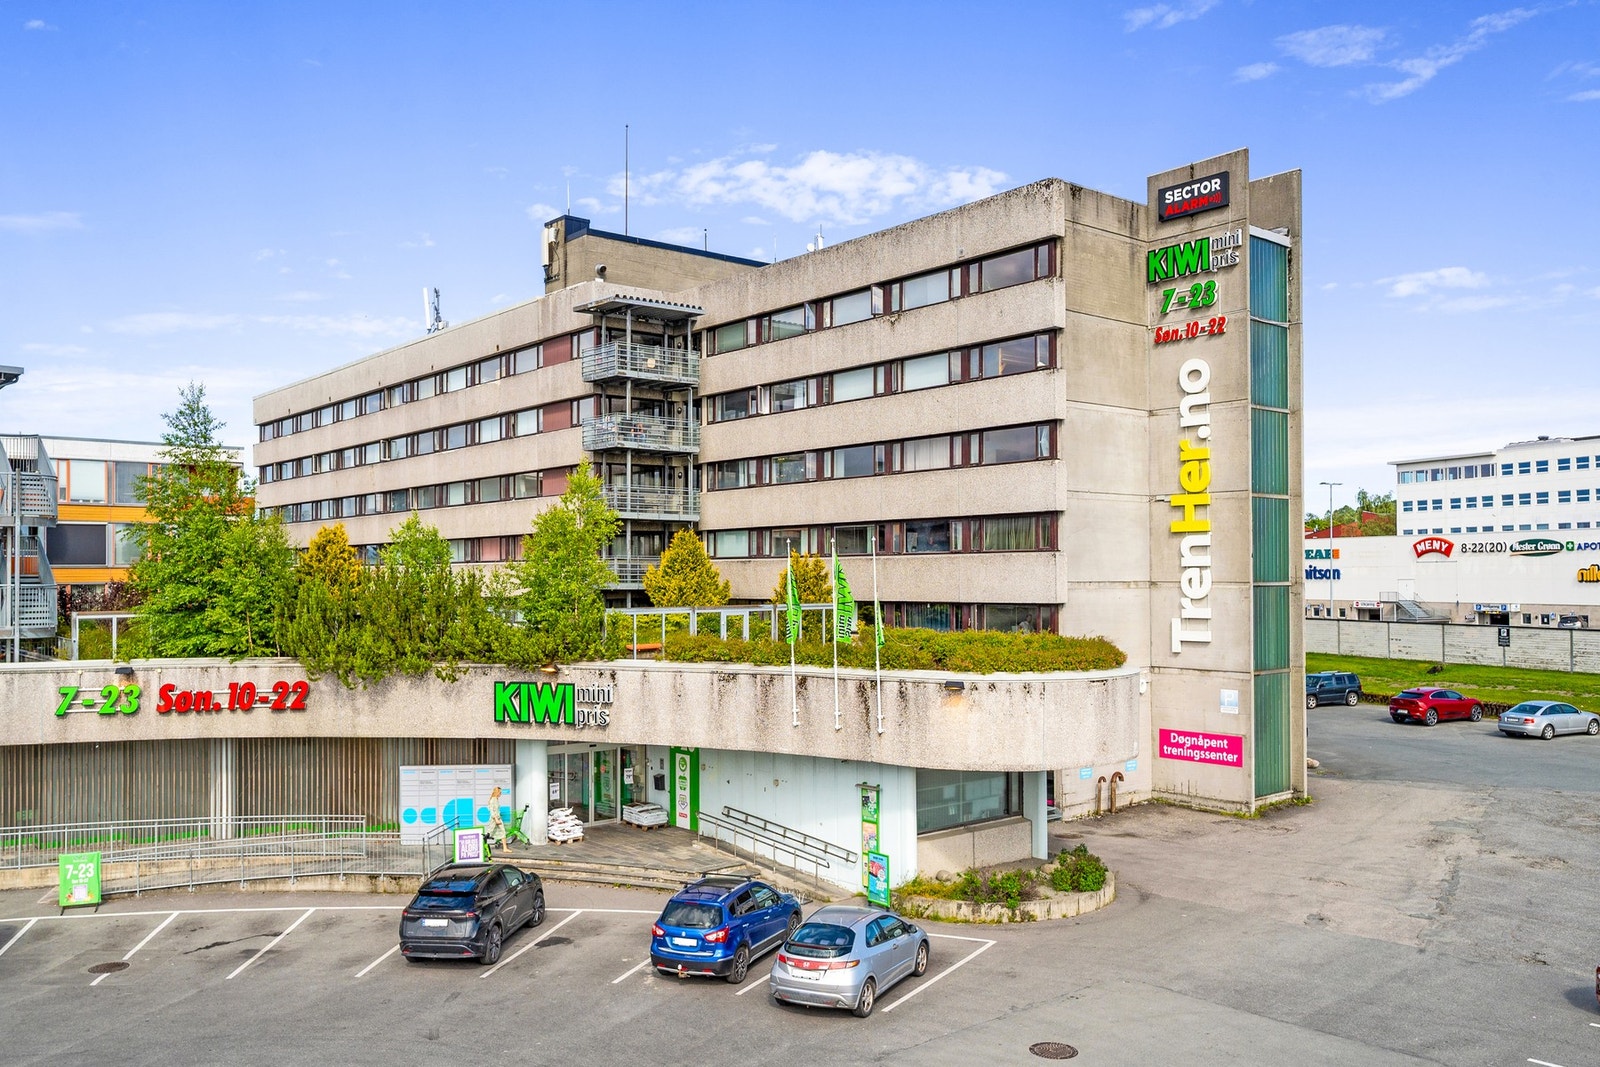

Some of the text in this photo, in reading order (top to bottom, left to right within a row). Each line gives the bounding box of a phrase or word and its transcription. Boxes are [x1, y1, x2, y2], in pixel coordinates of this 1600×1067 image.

[1164, 178, 1221, 204] SECTOR
[1165, 195, 1209, 217] ALARM
[1212, 229, 1242, 250] mini
[1148, 236, 1210, 283] KIWI
[1211, 250, 1240, 272] pris
[1160, 280, 1219, 314] 7-23
[1154, 316, 1228, 345] Søn. 10-22
[1170, 357, 1212, 654] TrenHer.no
[1416, 539, 1449, 553] MENY
[1461, 542, 1507, 554] 8-22(20)
[55, 684, 141, 716] 7-23
[156, 680, 310, 713] Søn. 10-22
[494, 681, 576, 725] KIWI
[576, 683, 614, 704] mini
[576, 705, 610, 728] pris
[1170, 732, 1229, 749] Døgnåpent
[1163, 745, 1238, 762] treningssenter
[65, 863, 95, 879] 7-23
